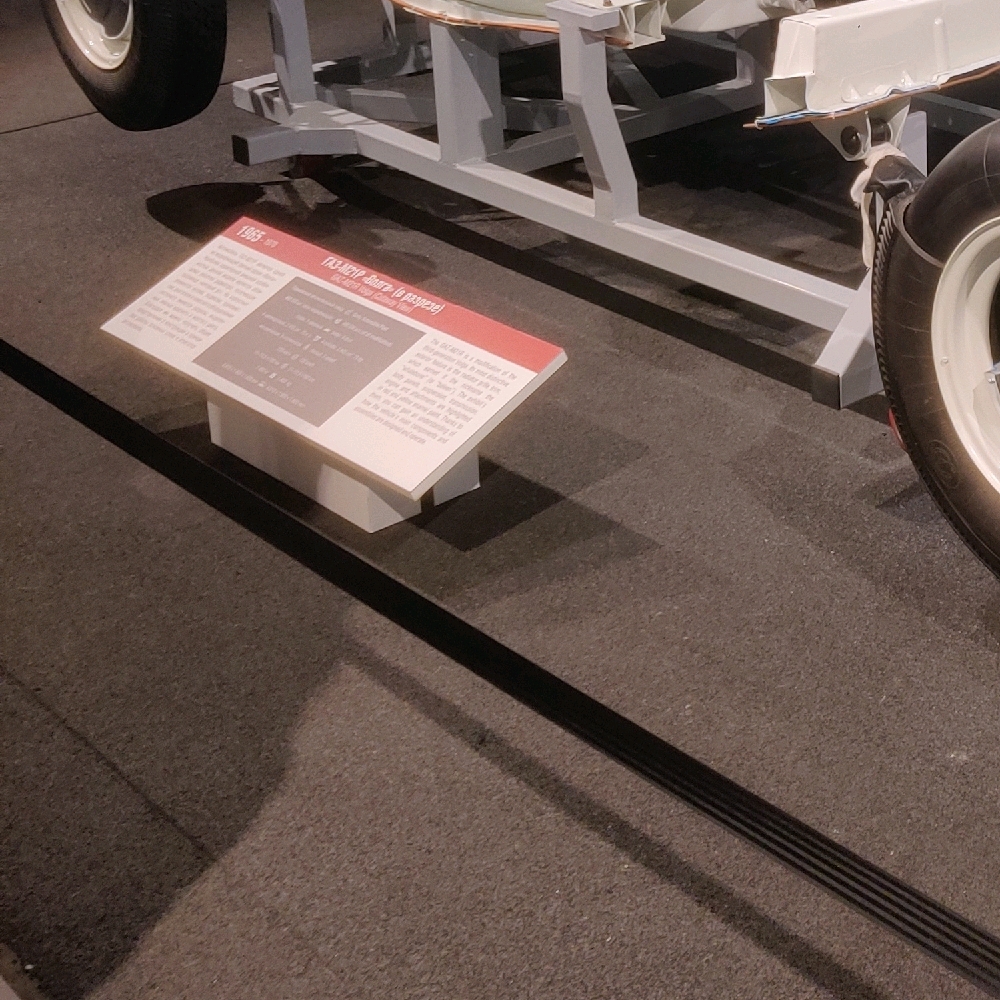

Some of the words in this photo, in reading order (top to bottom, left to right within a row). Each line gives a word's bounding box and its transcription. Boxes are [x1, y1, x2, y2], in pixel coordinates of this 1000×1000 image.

[236, 226, 266, 242] 1965
[321, 256, 366, 279] ГАЗ-М21Р
[400, 292, 446, 316] разрезе)
